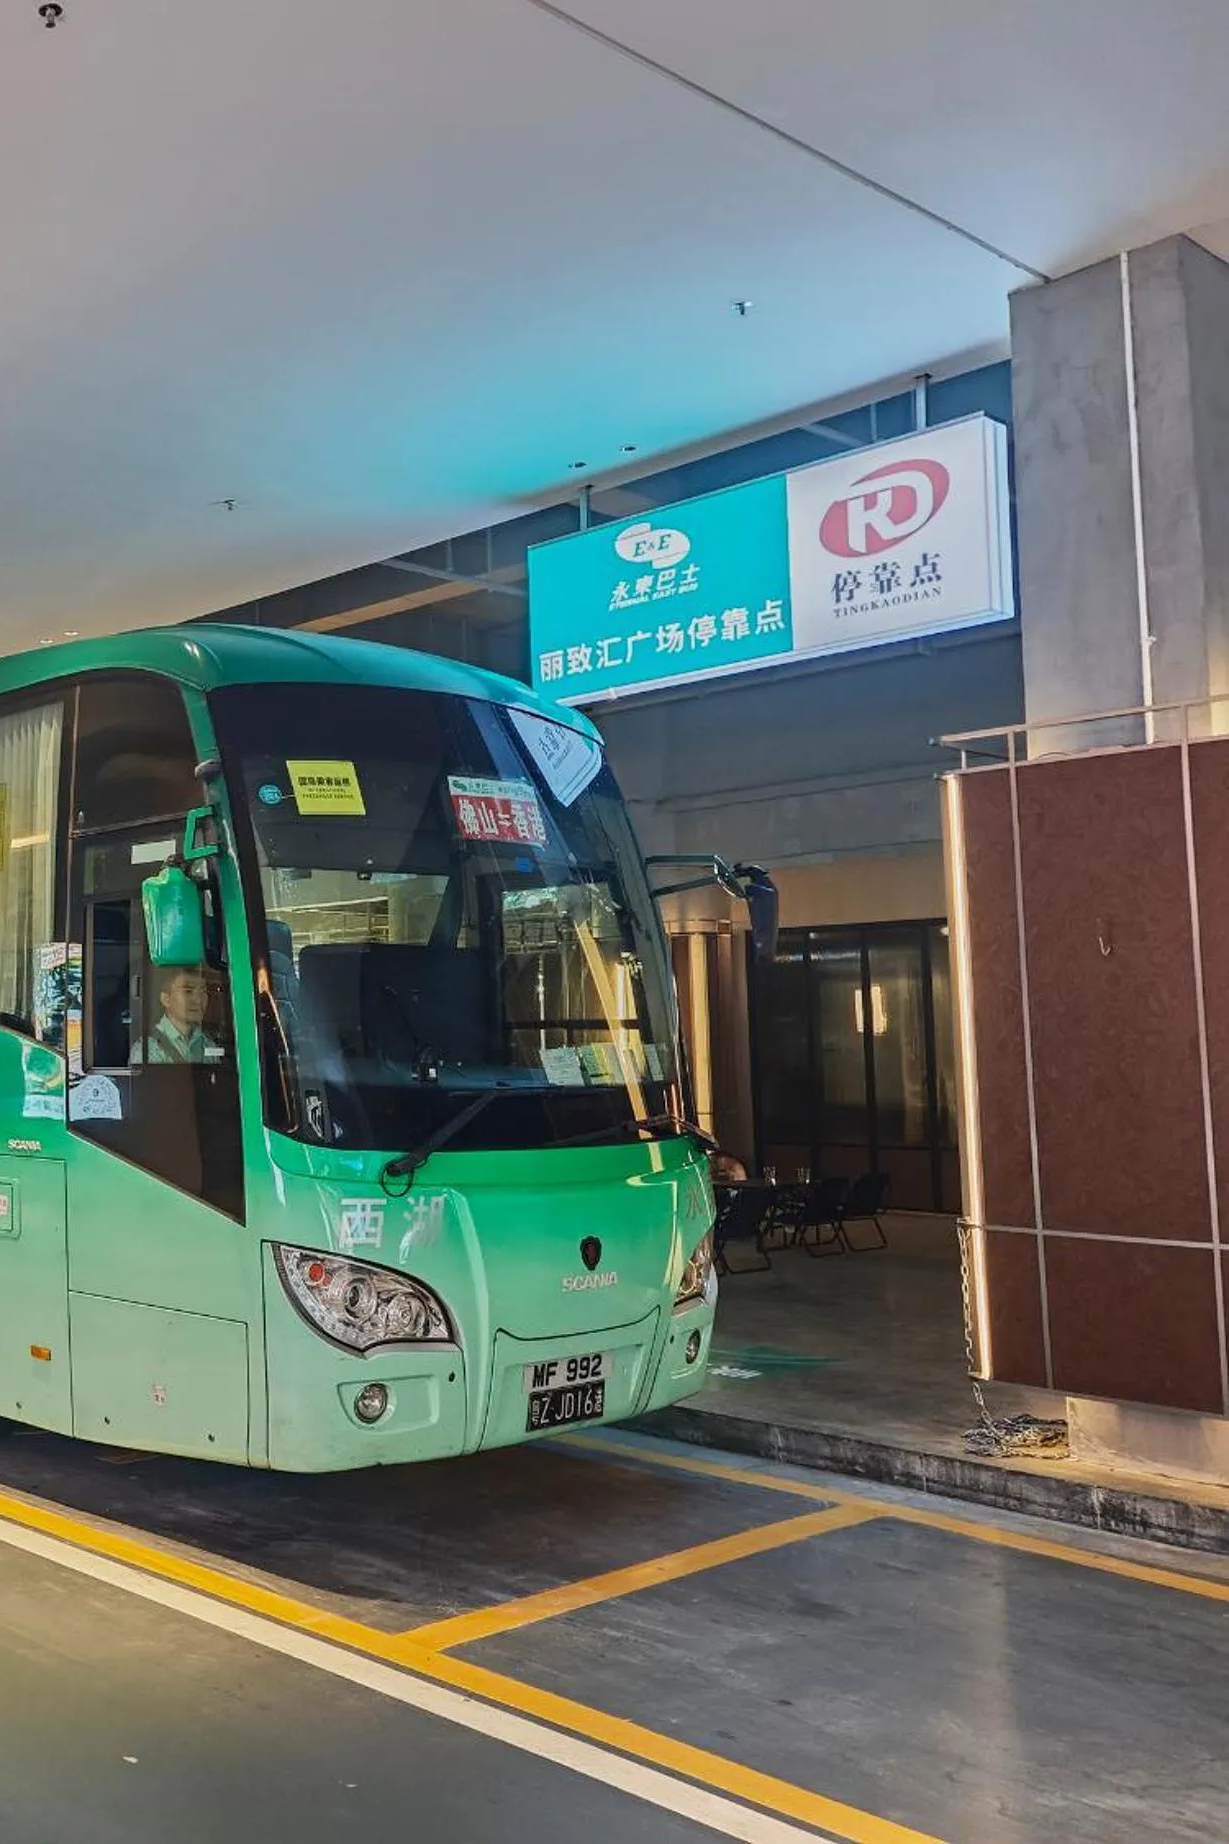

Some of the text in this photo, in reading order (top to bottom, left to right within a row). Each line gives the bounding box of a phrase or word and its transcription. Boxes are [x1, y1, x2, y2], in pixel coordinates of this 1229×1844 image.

[633, 533, 672, 557] E&E
[831, 552, 943, 604] 停靠点
[833, 586, 942, 618] TINGKAODIAN
[539, 599, 786, 682] 丽致汇广场停靠点
[7, 1139, 42, 1150] SCANIA
[561, 1271, 618, 1292] SCANIA
[533, 1354, 603, 1388] MF 992
